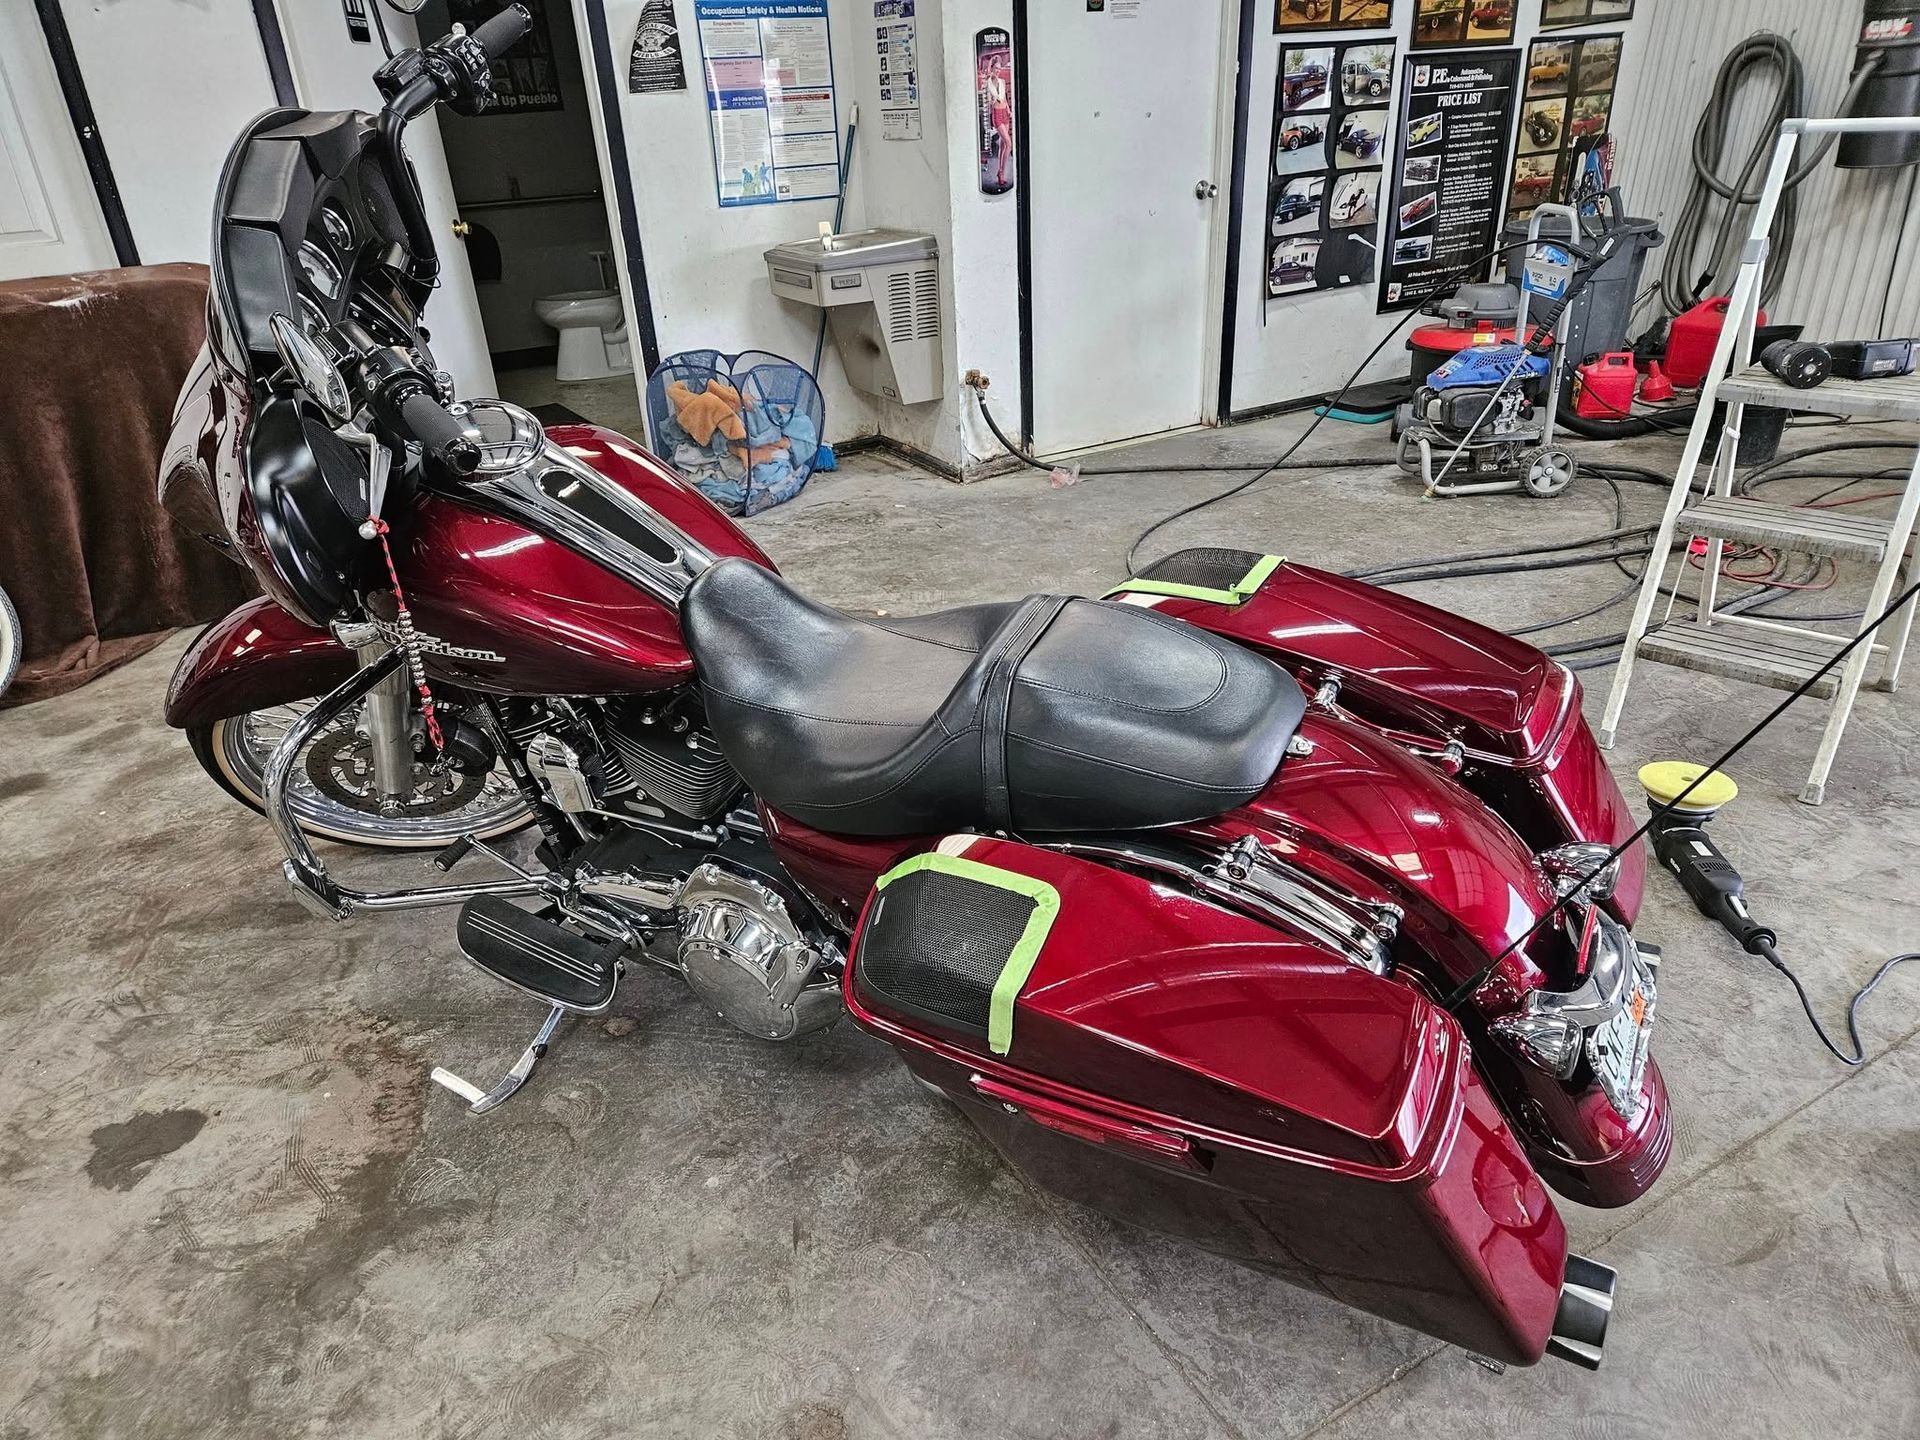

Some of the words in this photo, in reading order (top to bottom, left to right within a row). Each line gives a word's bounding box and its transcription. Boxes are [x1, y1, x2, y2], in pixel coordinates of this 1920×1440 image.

[701, 7, 746, 17] Occupational
[747, 7, 768, 16] Safety
[769, 6, 775, 14] &
[776, 5, 797, 14] Health
[798, 5, 823, 14] Notices
[501, 95, 517, 107] Up
[518, 93, 558, 105] Pueblo
[1437, 94, 1462, 107] PRICE
[1463, 92, 1483, 105] LIST
